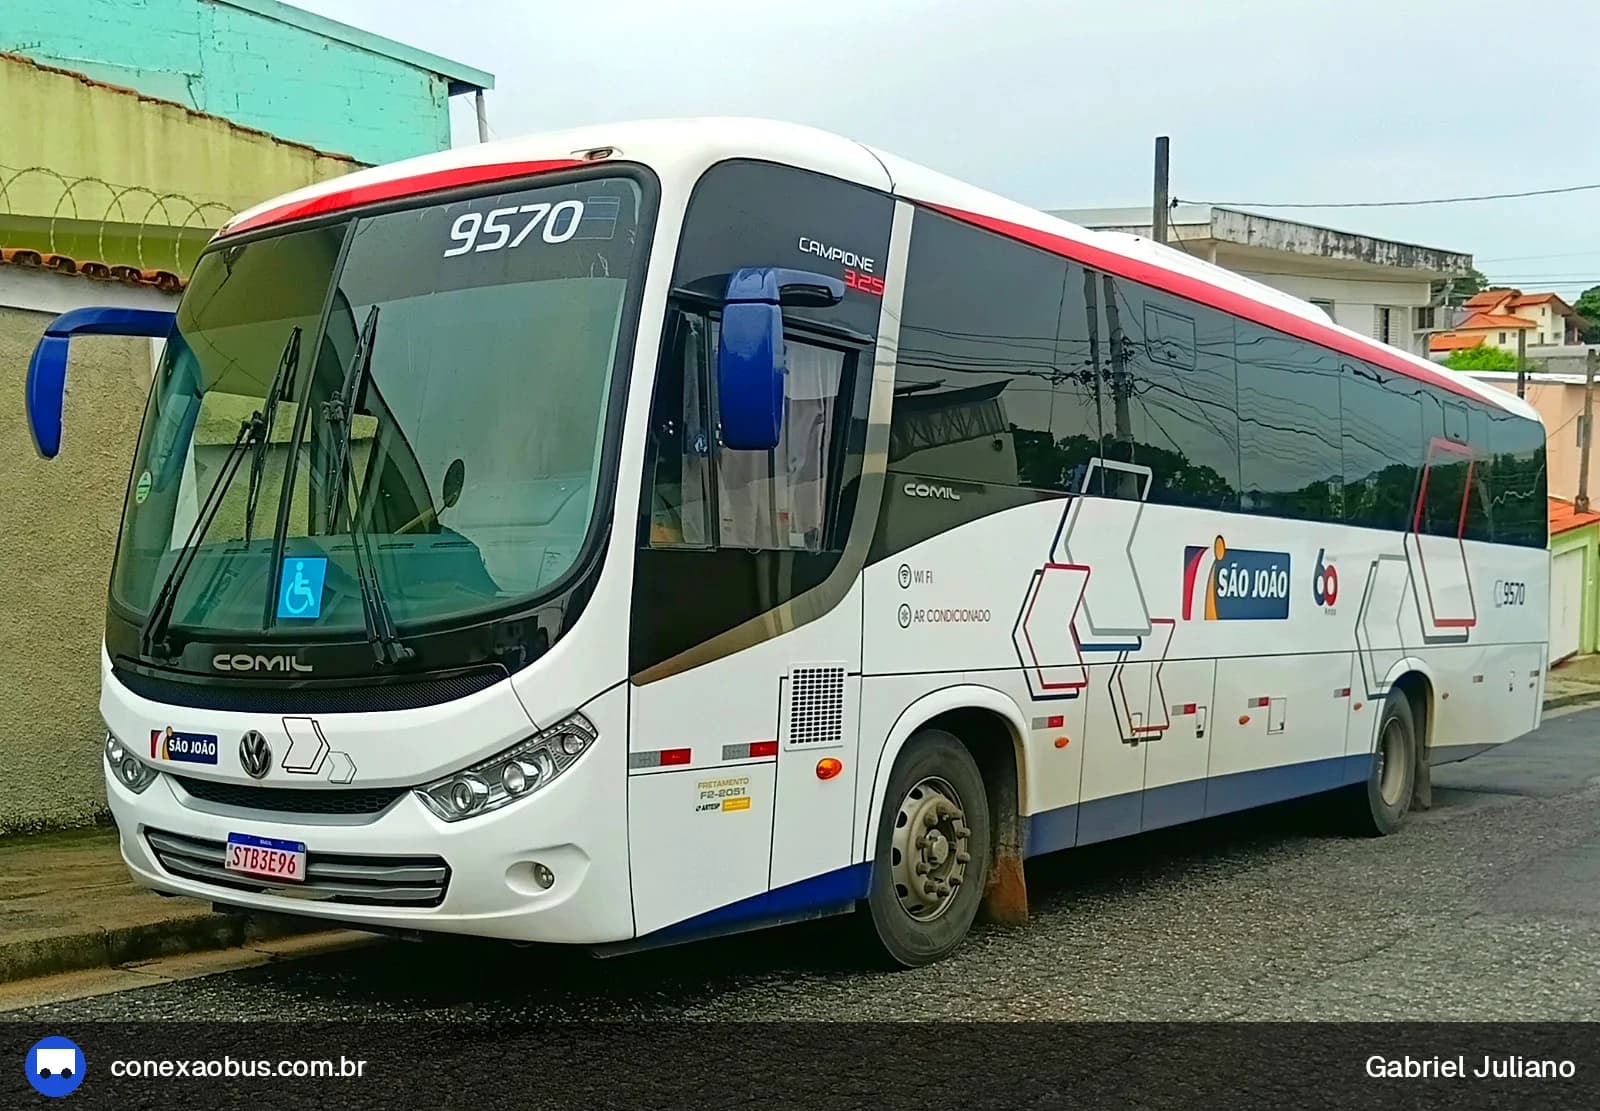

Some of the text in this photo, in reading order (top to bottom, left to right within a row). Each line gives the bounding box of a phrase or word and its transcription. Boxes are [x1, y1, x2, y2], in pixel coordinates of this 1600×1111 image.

[443, 200, 584, 258] 9570
[799, 236, 875, 273] CAMPIONE
[844, 268, 884, 296] 3.25
[904, 483, 961, 500] COMIL
[913, 570, 933, 584] WI FI
[1217, 562, 1288, 598] SÃO JOÃO
[1313, 547, 1338, 606] 60
[1503, 582, 1525, 606] 9570
[913, 609, 991, 623] AR CONDICIONADO
[212, 654, 313, 672] COMIL
[168, 738, 216, 756] SÃO JOÃO
[700, 787, 746, 800] F2-2051
[232, 846, 296, 875] STB3E96
